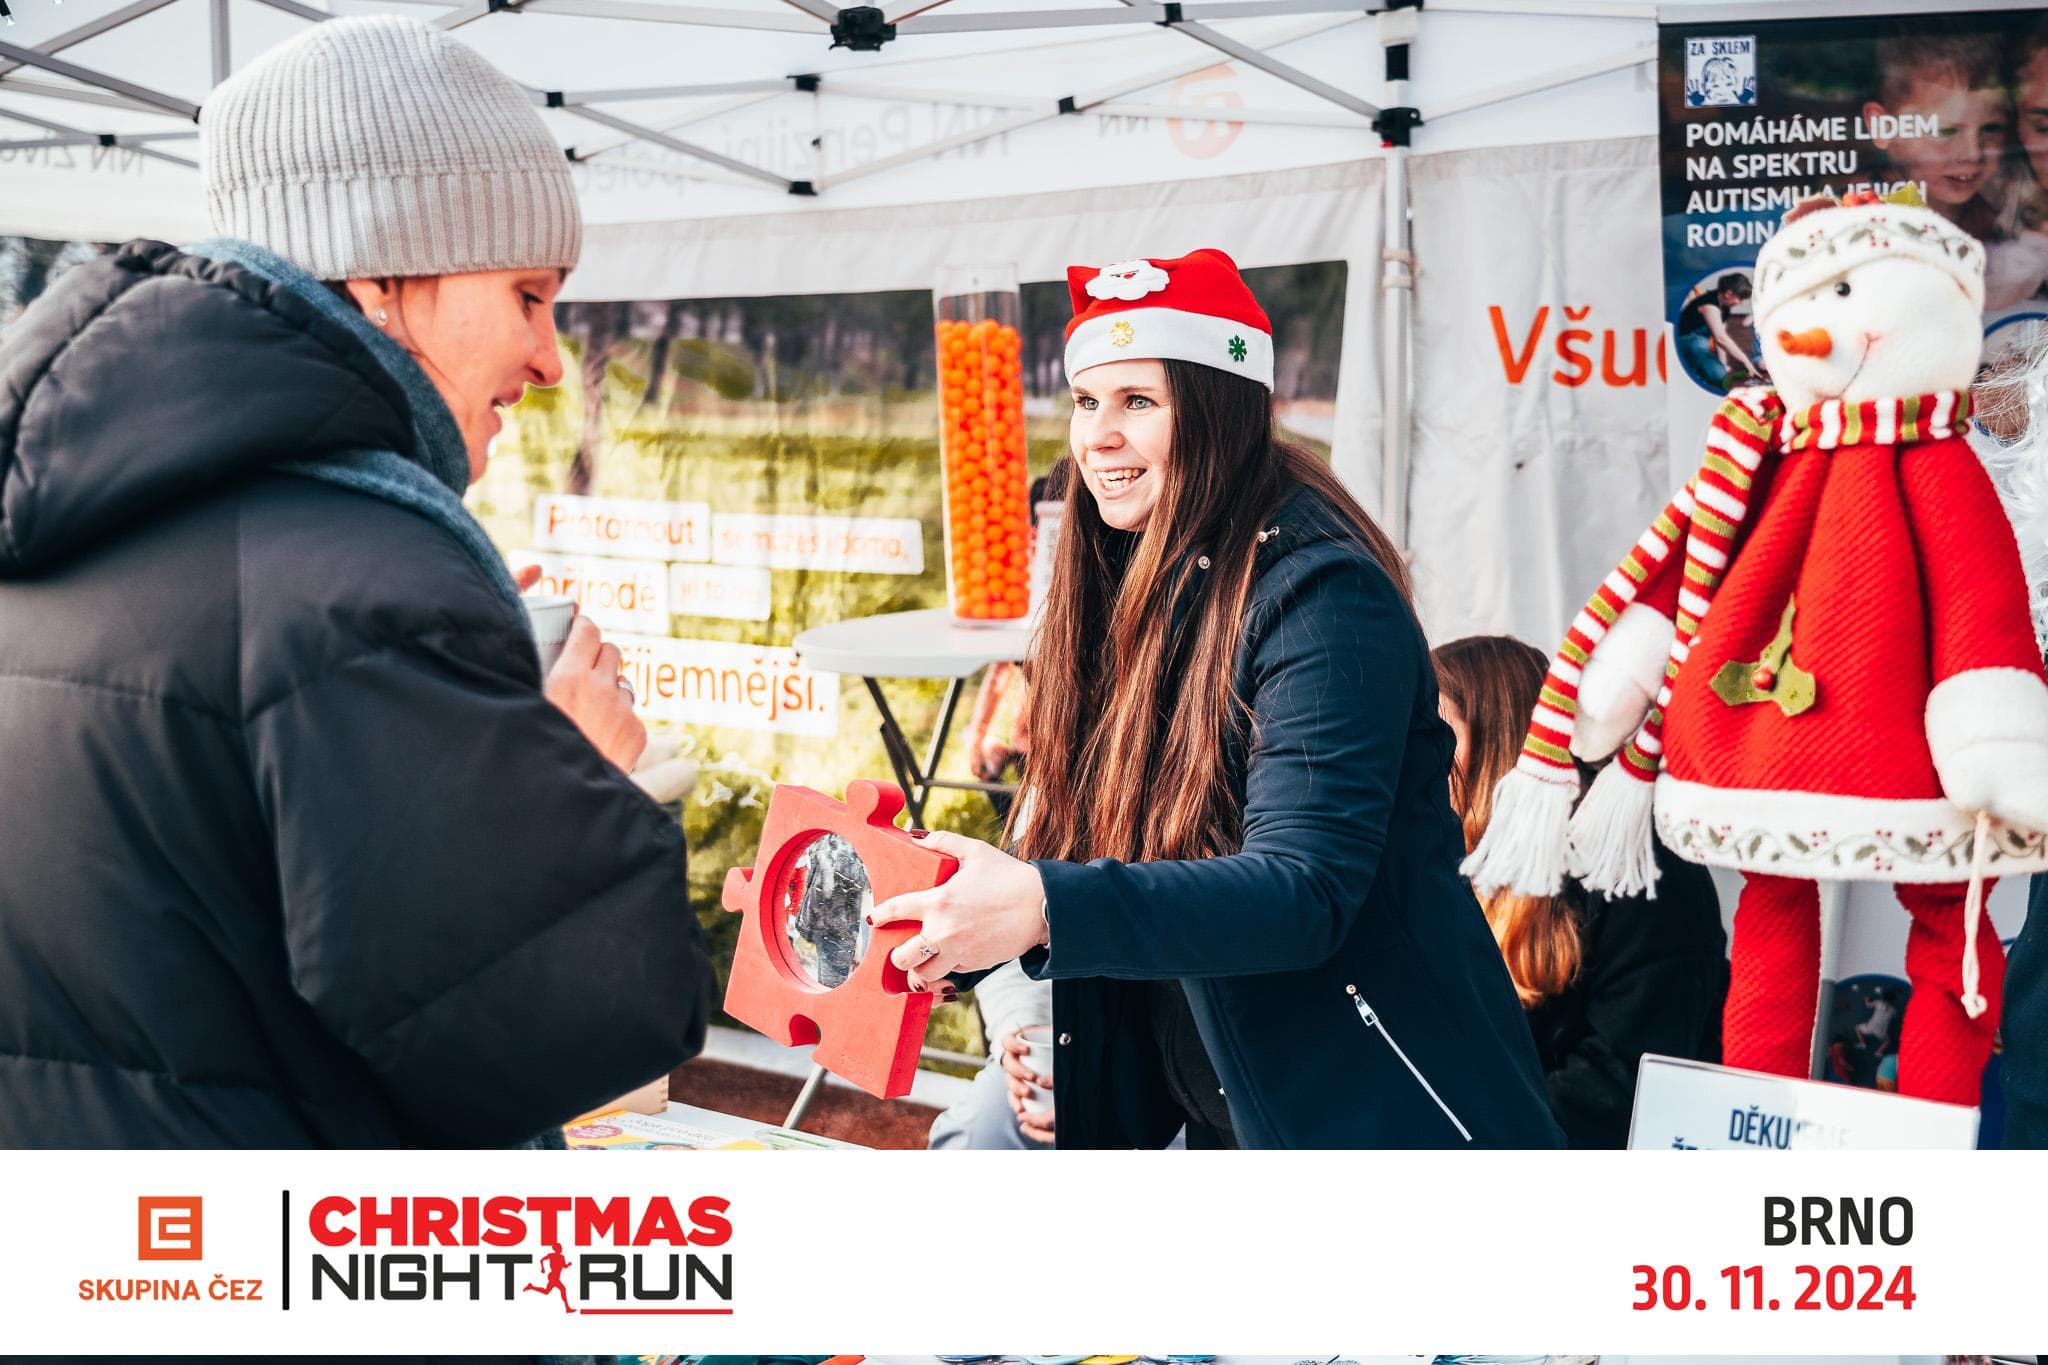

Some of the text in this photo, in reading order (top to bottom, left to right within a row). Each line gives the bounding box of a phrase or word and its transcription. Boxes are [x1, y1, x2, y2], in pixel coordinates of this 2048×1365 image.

[1690, 40, 1751, 56] ZA SKLEM
[1686, 113, 1939, 148] POMÁHÁME LIDEM
[1686, 149, 1858, 181] NA SPEKTRU
[1686, 221, 1778, 248] RODIN
